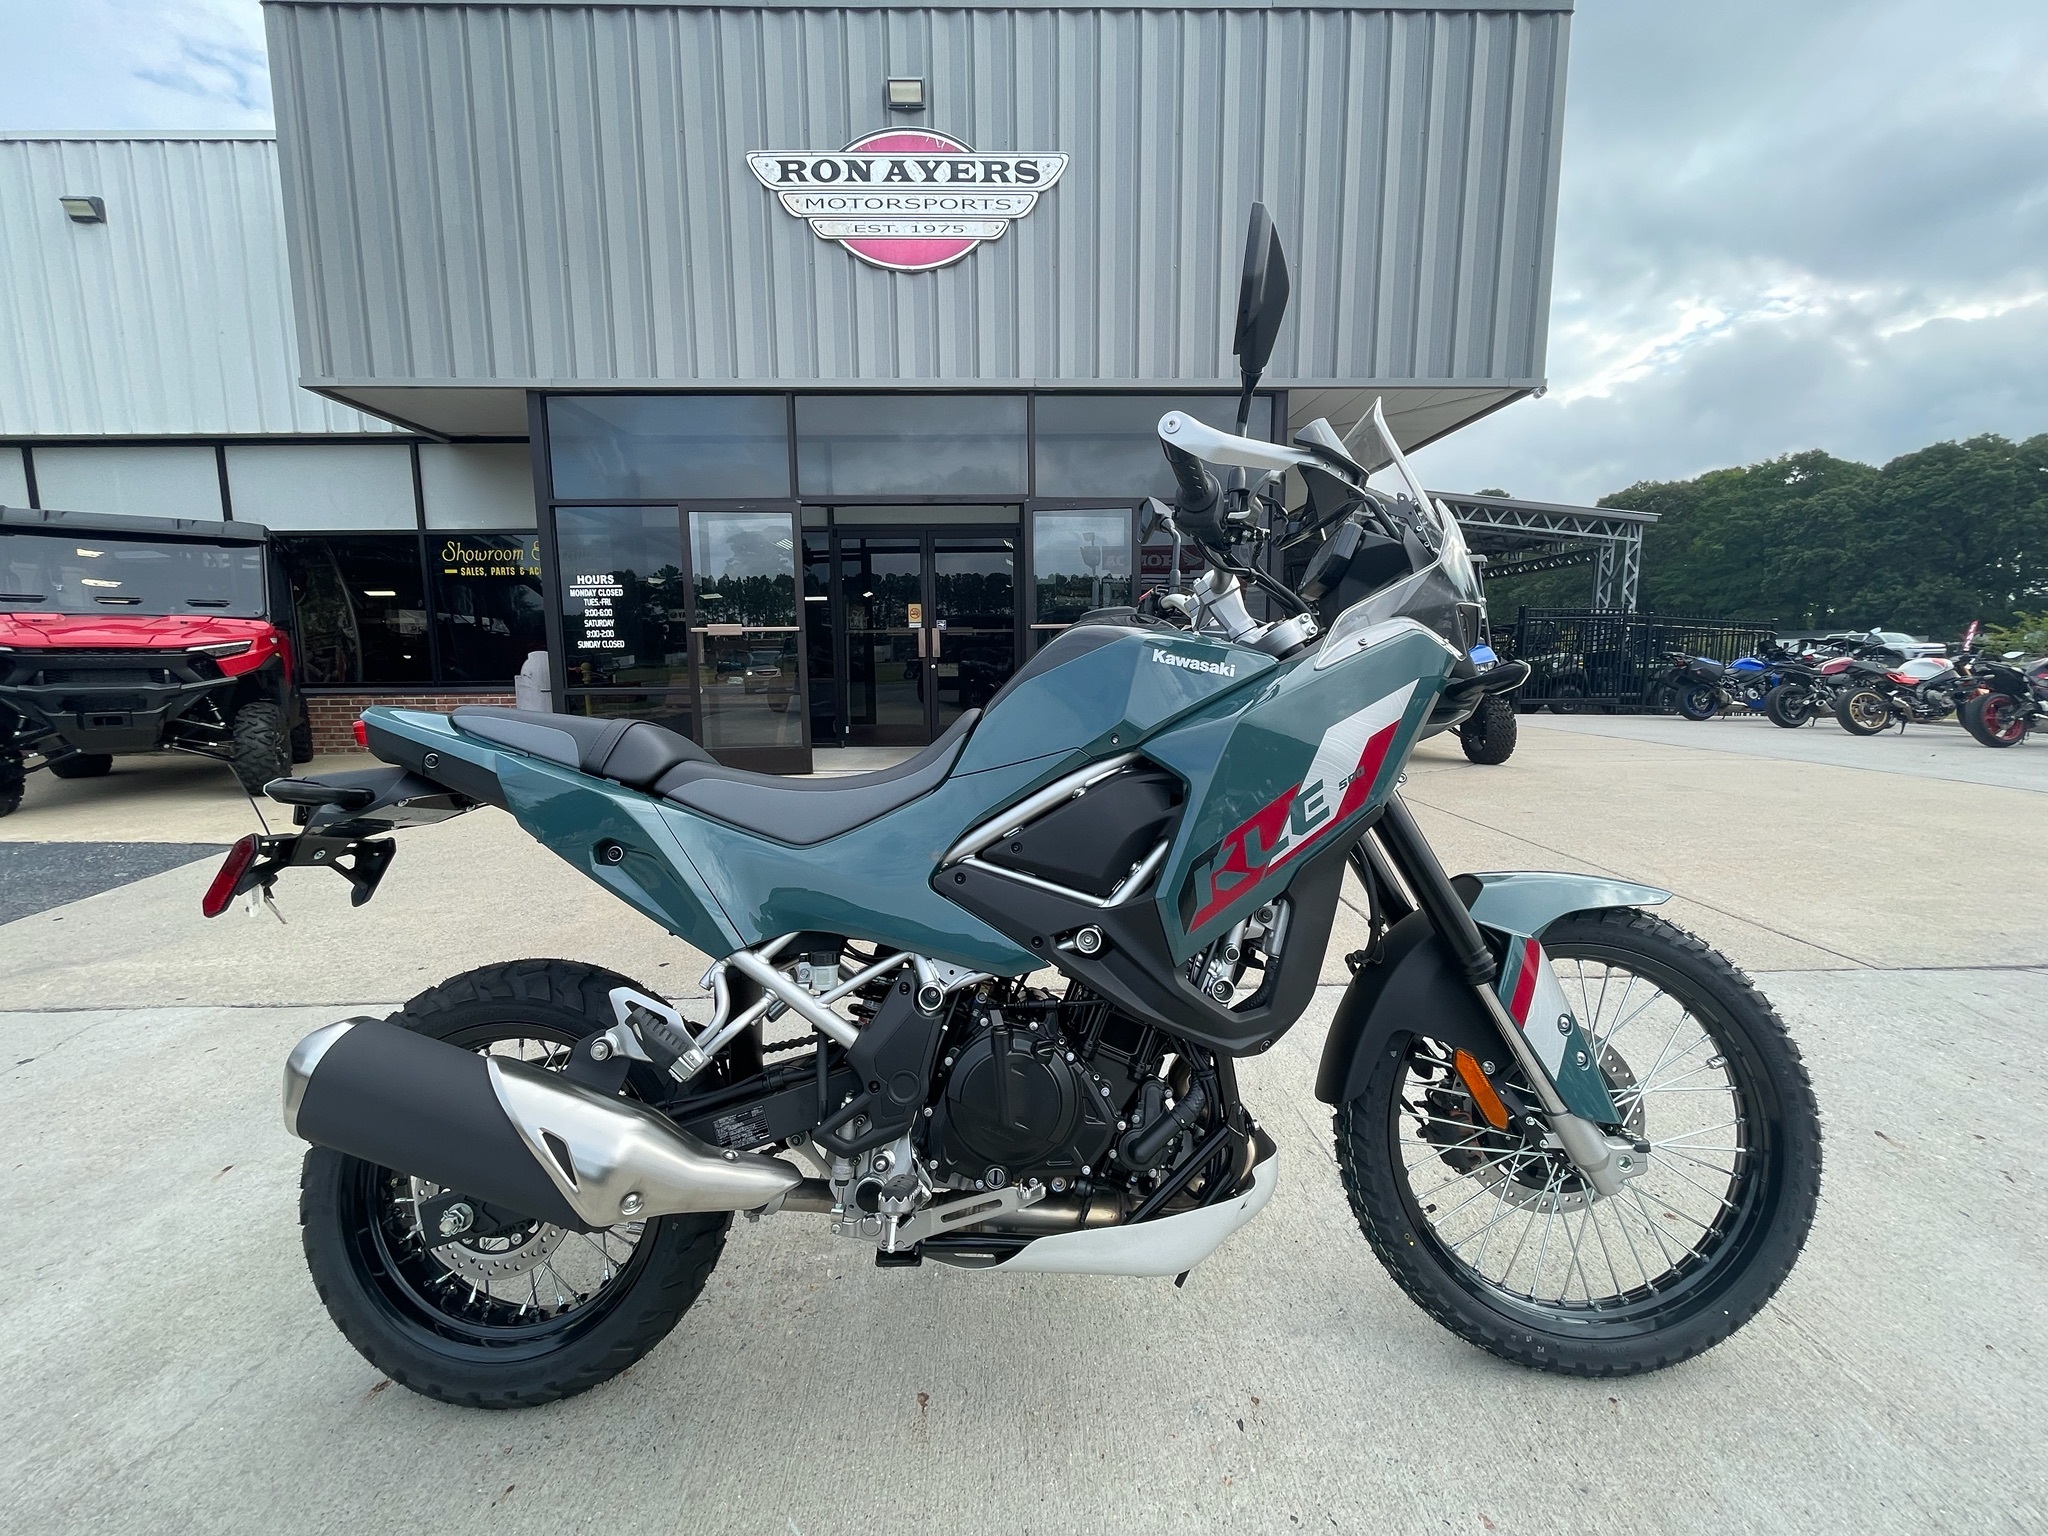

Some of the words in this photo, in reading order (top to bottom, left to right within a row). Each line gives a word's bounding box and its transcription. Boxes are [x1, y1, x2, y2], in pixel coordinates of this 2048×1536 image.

[775, 159, 872, 183] RON
[883, 159, 1041, 184] AYERS
[805, 197, 1012, 211] MOTORSPORTS
[854, 224, 899, 233] EST.
[911, 224, 964, 234] 1975
[442, 541, 524, 563] Showroom
[461, 567, 487, 577] SALES,
[491, 567, 515, 576] PARTS
[577, 575, 615, 585] HOURS
[570, 589, 597, 597] MONDAY
[598, 588, 624, 597] CLOSED
[584, 608, 613, 617] 9:00-6:00
[584, 619, 615, 628] SATURDAY
[586, 630, 615, 638] 9:00-2:00
[578, 640, 601, 649] SUNDAY
[602, 640, 625, 649] CLOSED
[1152, 648, 1236, 678] Kawasaki
[1194, 778, 1331, 905] KLE
